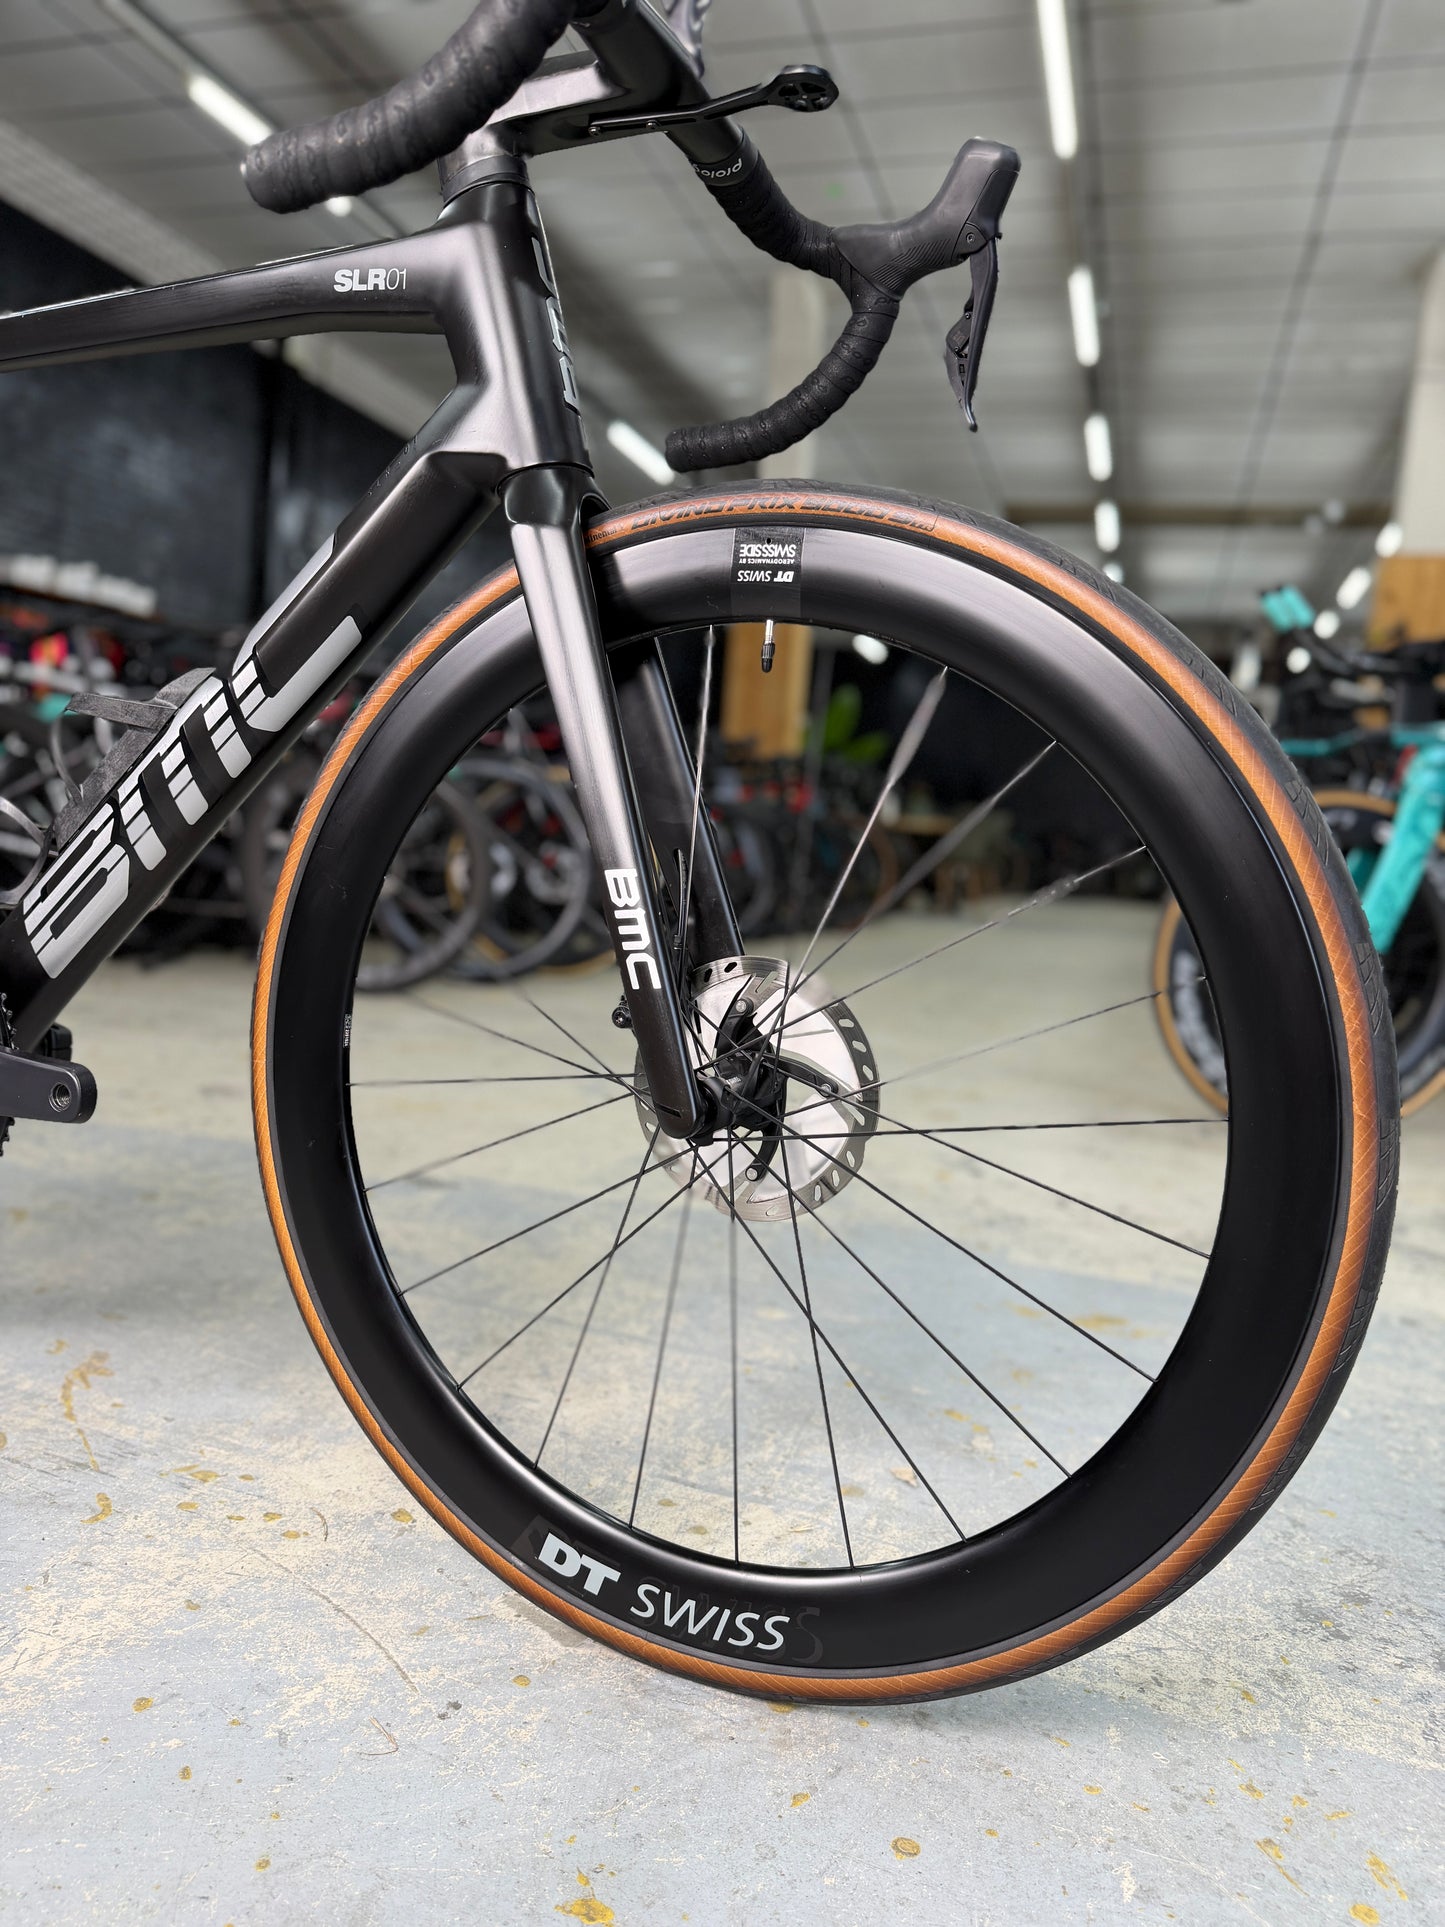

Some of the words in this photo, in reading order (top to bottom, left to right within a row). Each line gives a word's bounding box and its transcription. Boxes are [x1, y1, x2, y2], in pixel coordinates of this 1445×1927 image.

[333, 267, 407, 293] SLR01
[727, 497, 800, 512] PRIX
[737, 569, 772, 582] SWISS
[773, 570, 794, 582] DT
[604, 868, 662, 990] BMC
[538, 1532, 621, 1597] DT
[630, 1583, 790, 1651] SWISS
